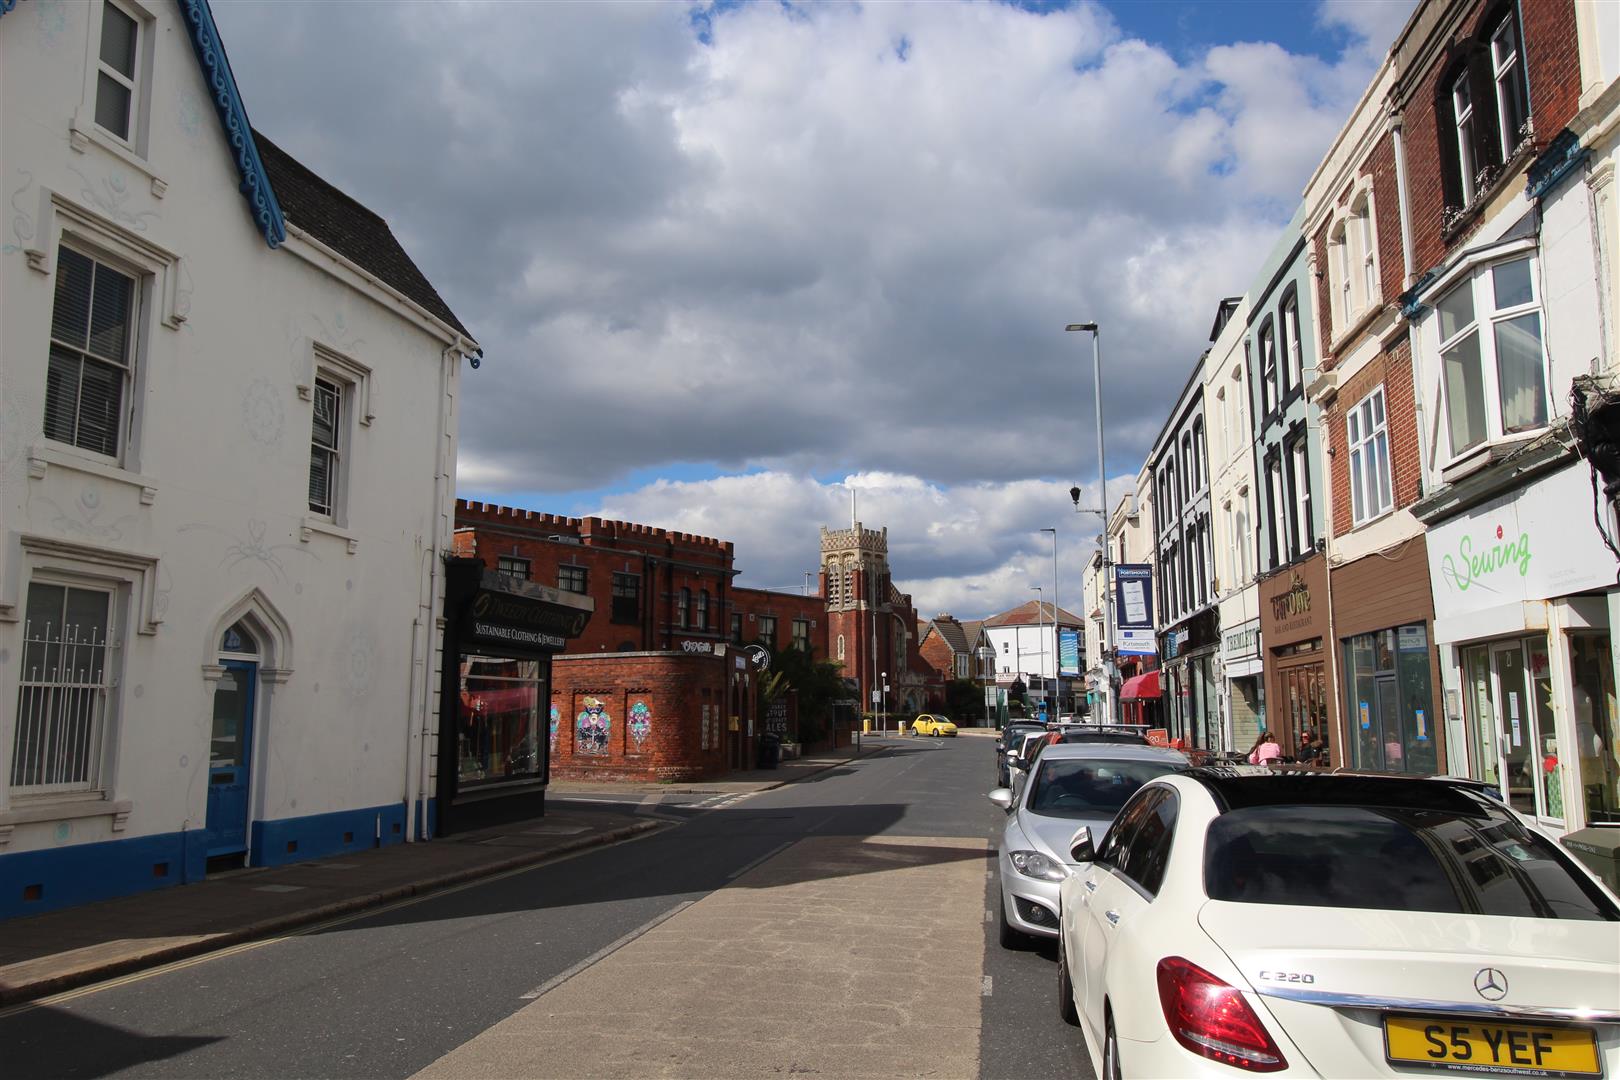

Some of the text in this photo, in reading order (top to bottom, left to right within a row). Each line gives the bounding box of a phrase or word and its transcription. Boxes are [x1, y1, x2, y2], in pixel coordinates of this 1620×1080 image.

[1442, 525, 1532, 591] Sewing
[475, 622, 511, 638] SUSTAINABLE
[511, 628, 538, 643] CLOTHING
[542, 635, 565, 646] JEWELLERY
[1274, 972, 1315, 984] 220
[1424, 1025, 1553, 1066] S5 YEF
[1447, 1064, 1548, 1077] www.mercedes-benzsouthwest.co.uk
